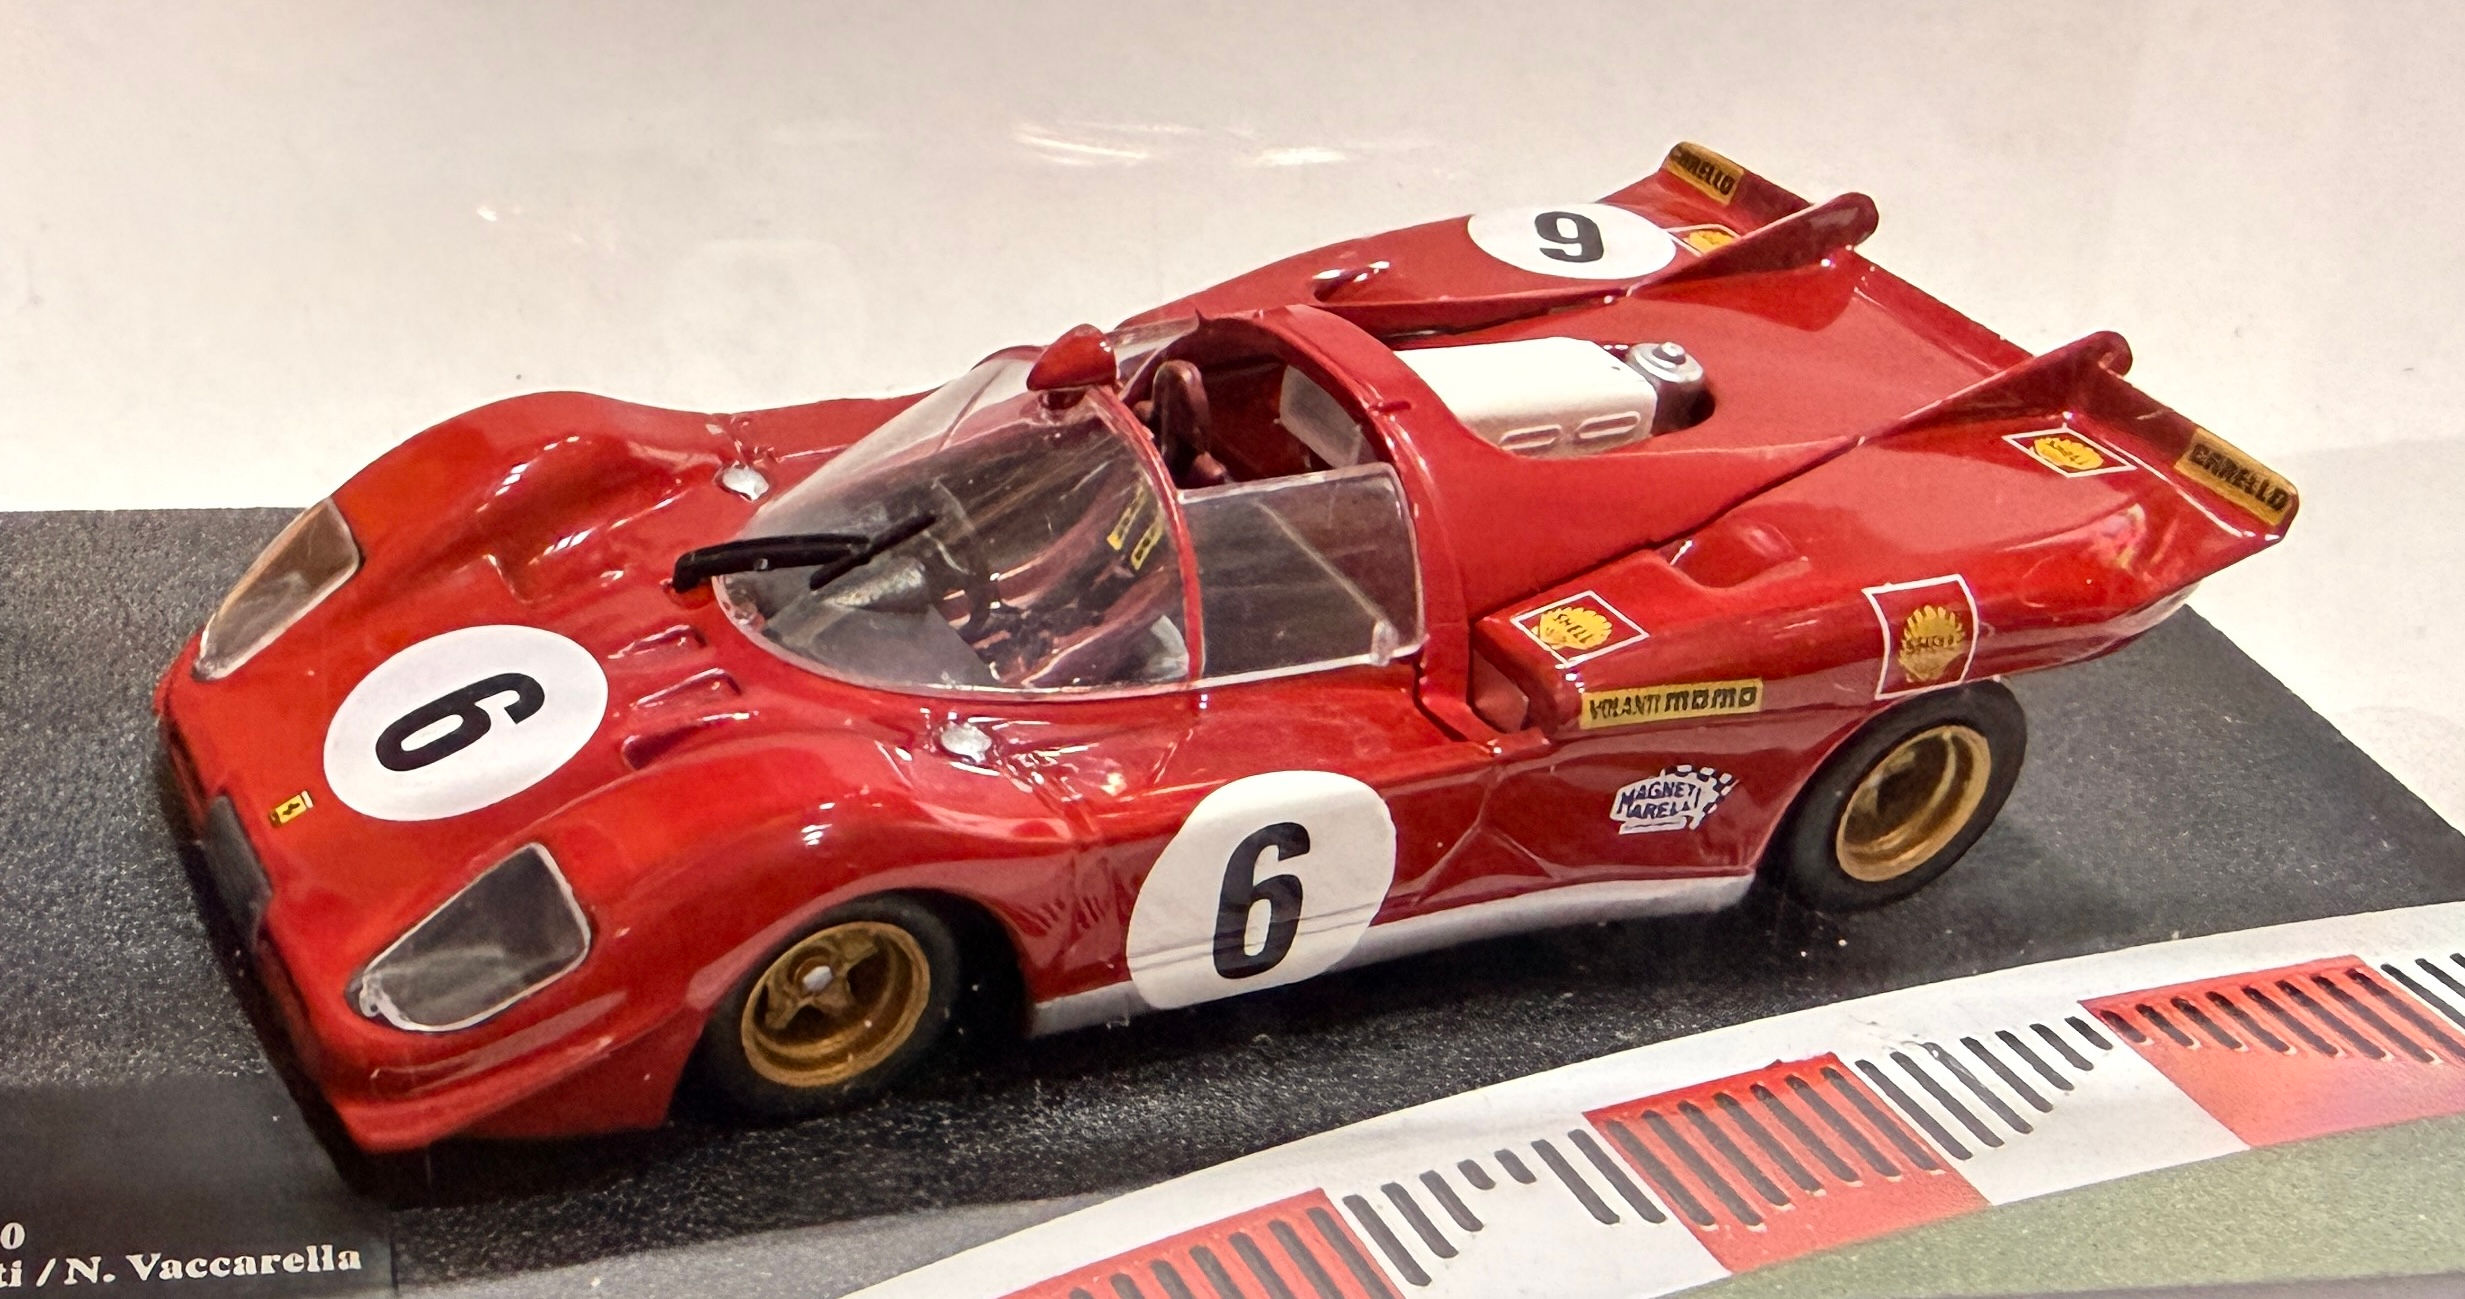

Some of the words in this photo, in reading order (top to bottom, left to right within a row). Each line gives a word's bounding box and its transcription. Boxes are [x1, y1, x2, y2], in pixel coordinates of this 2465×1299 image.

[1617, 782, 1702, 808] MAGNETI
[1213, 822, 1310, 979] 6
[64, 1256, 117, 1285] N.
[125, 1244, 363, 1281] Vaccarella
